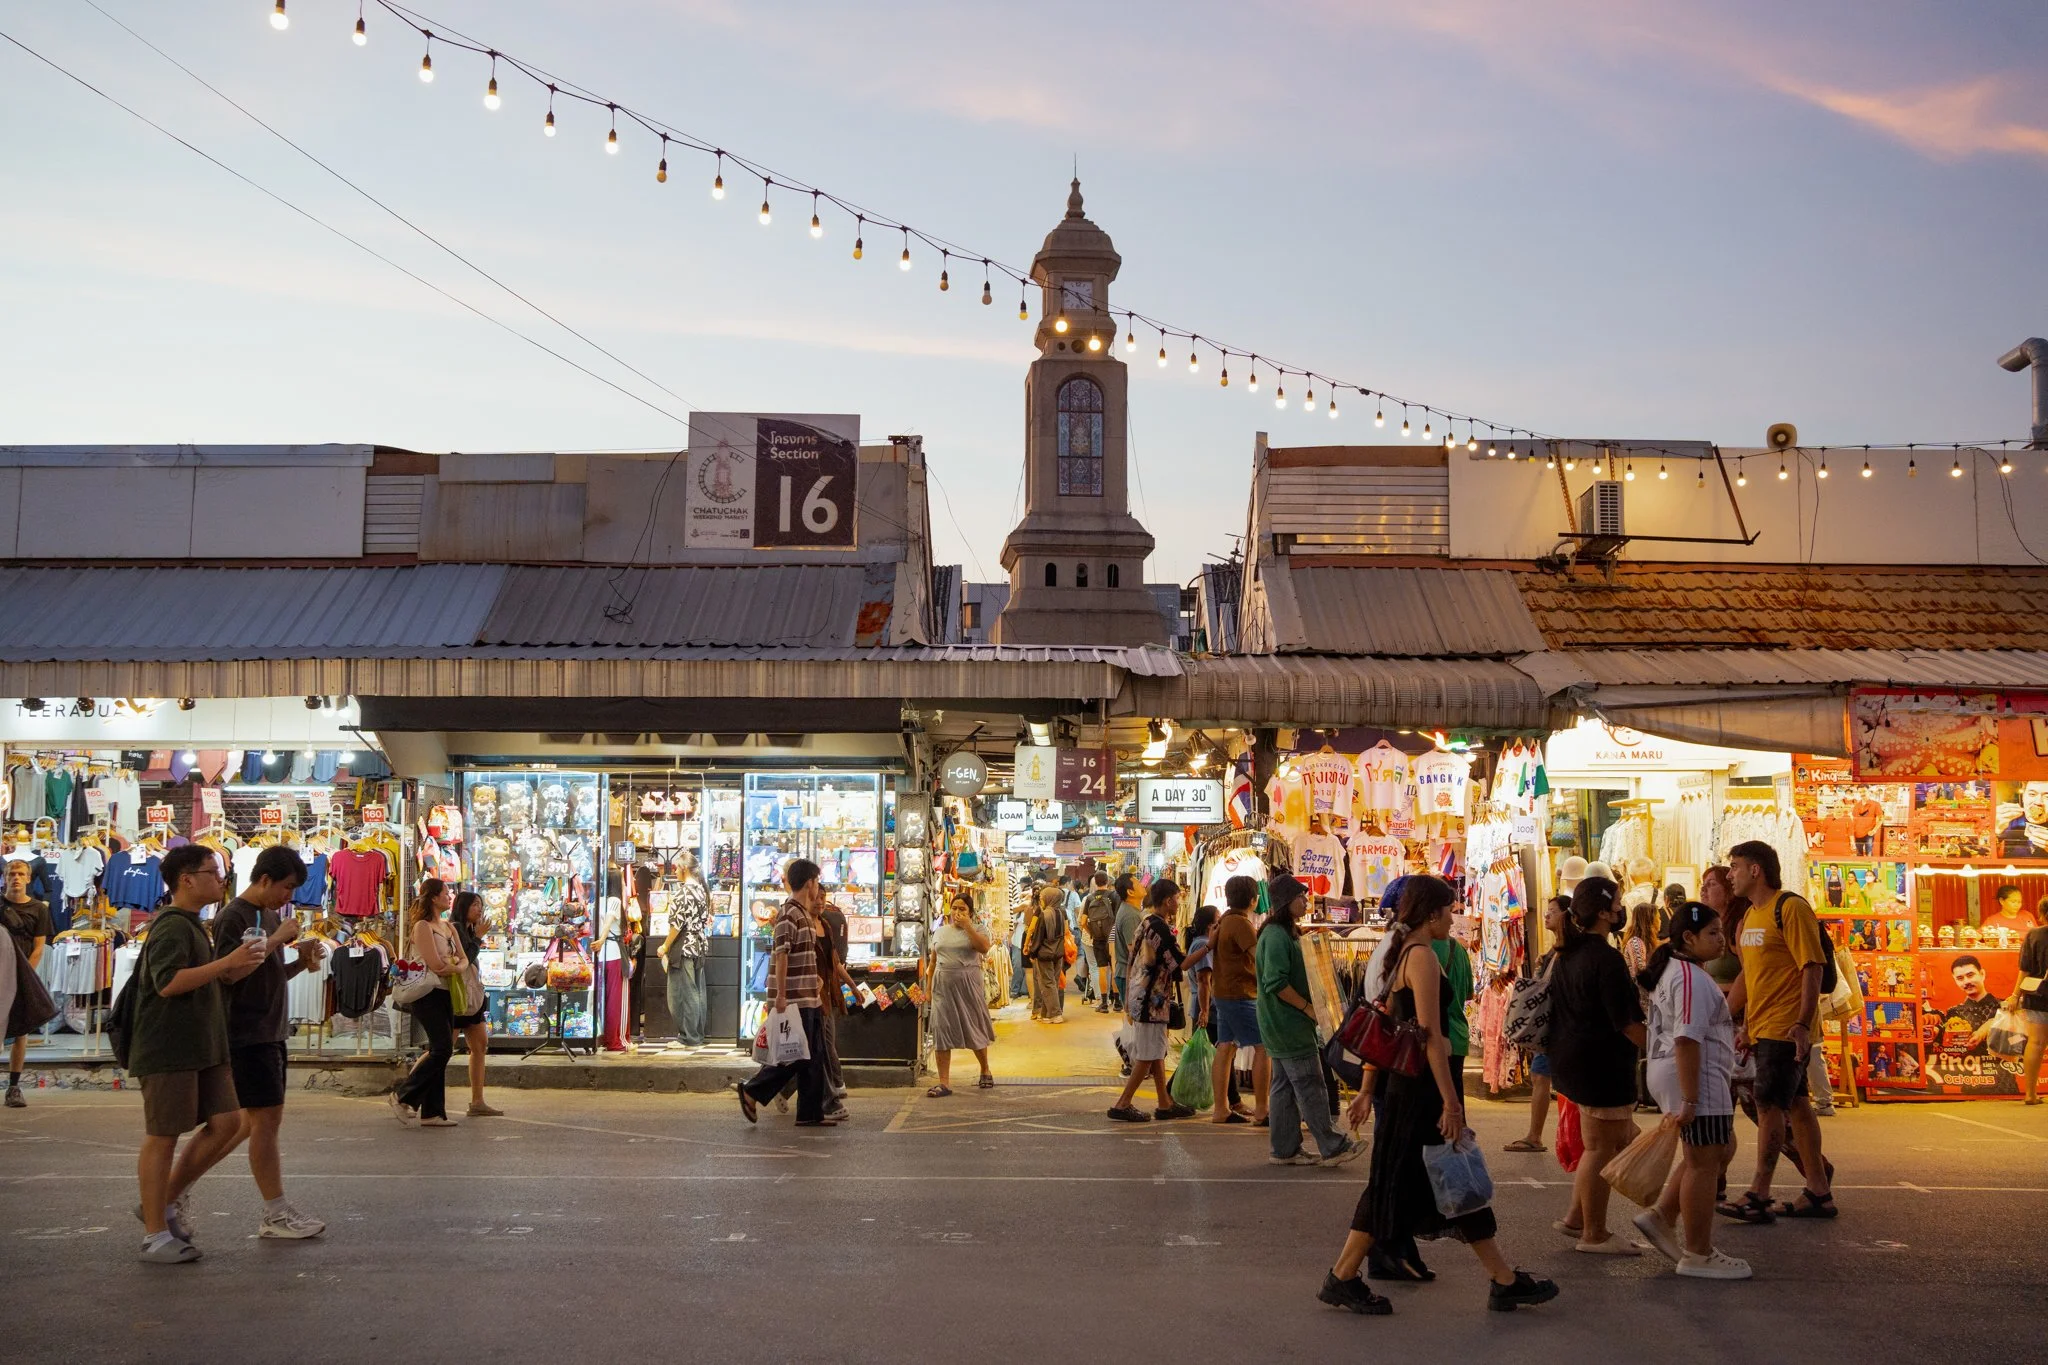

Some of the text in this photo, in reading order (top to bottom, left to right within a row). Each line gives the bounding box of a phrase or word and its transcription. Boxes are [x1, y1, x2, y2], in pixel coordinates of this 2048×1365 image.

[771, 431, 818, 444] โครงการ
[770, 446, 819, 459] Section
[779, 475, 838, 534] 16
[1596, 751, 1663, 760] KANA MARU
[1082, 757, 1096, 768] 16
[1079, 774, 1107, 794] 24
[1152, 789, 1159, 801] A
[1166, 789, 1186, 802] DAY
[150, 810, 166, 818] 160
[364, 810, 382, 818] 160
[1356, 845, 1398, 856] FARMERS
[1302, 850, 1332, 866] Berry
[548, 861, 568, 873] 390
[1299, 863, 1334, 876] Infusion
[857, 924, 872, 936] 60
[1944, 1074, 1996, 1086] Octopus
